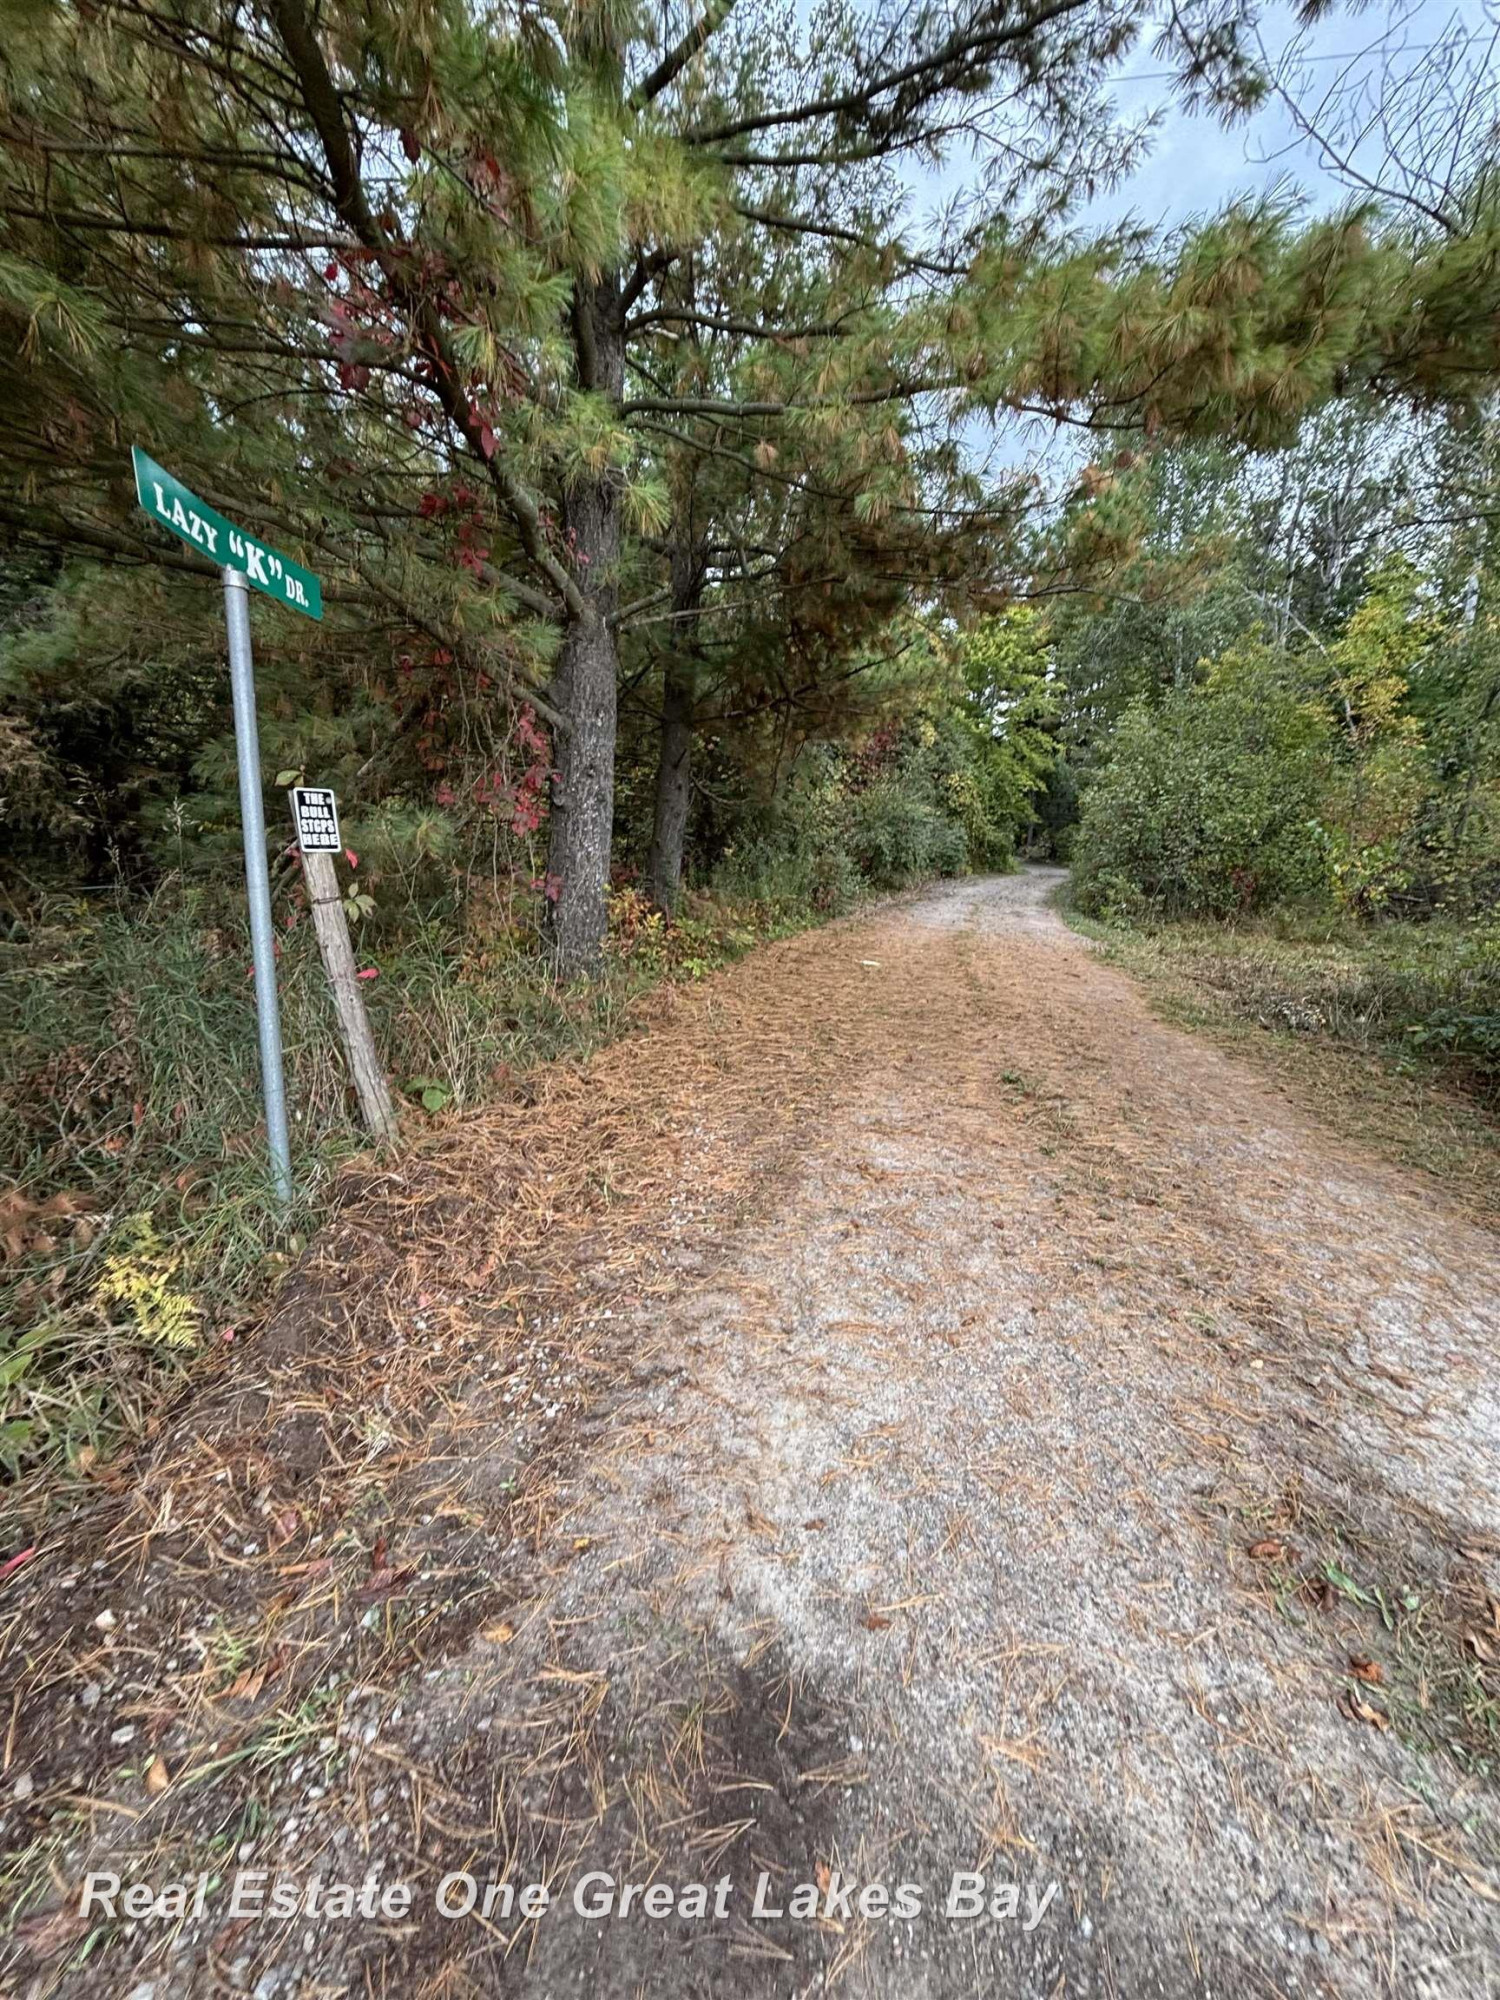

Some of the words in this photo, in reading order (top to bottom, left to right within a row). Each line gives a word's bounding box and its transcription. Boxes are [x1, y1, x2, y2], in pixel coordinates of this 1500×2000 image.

[153, 481, 218, 553] LAZY
[285, 574, 309, 607] DR.
[303, 792, 325, 805] THE
[300, 805, 330, 818] BULL
[302, 833, 339, 846] HERE
